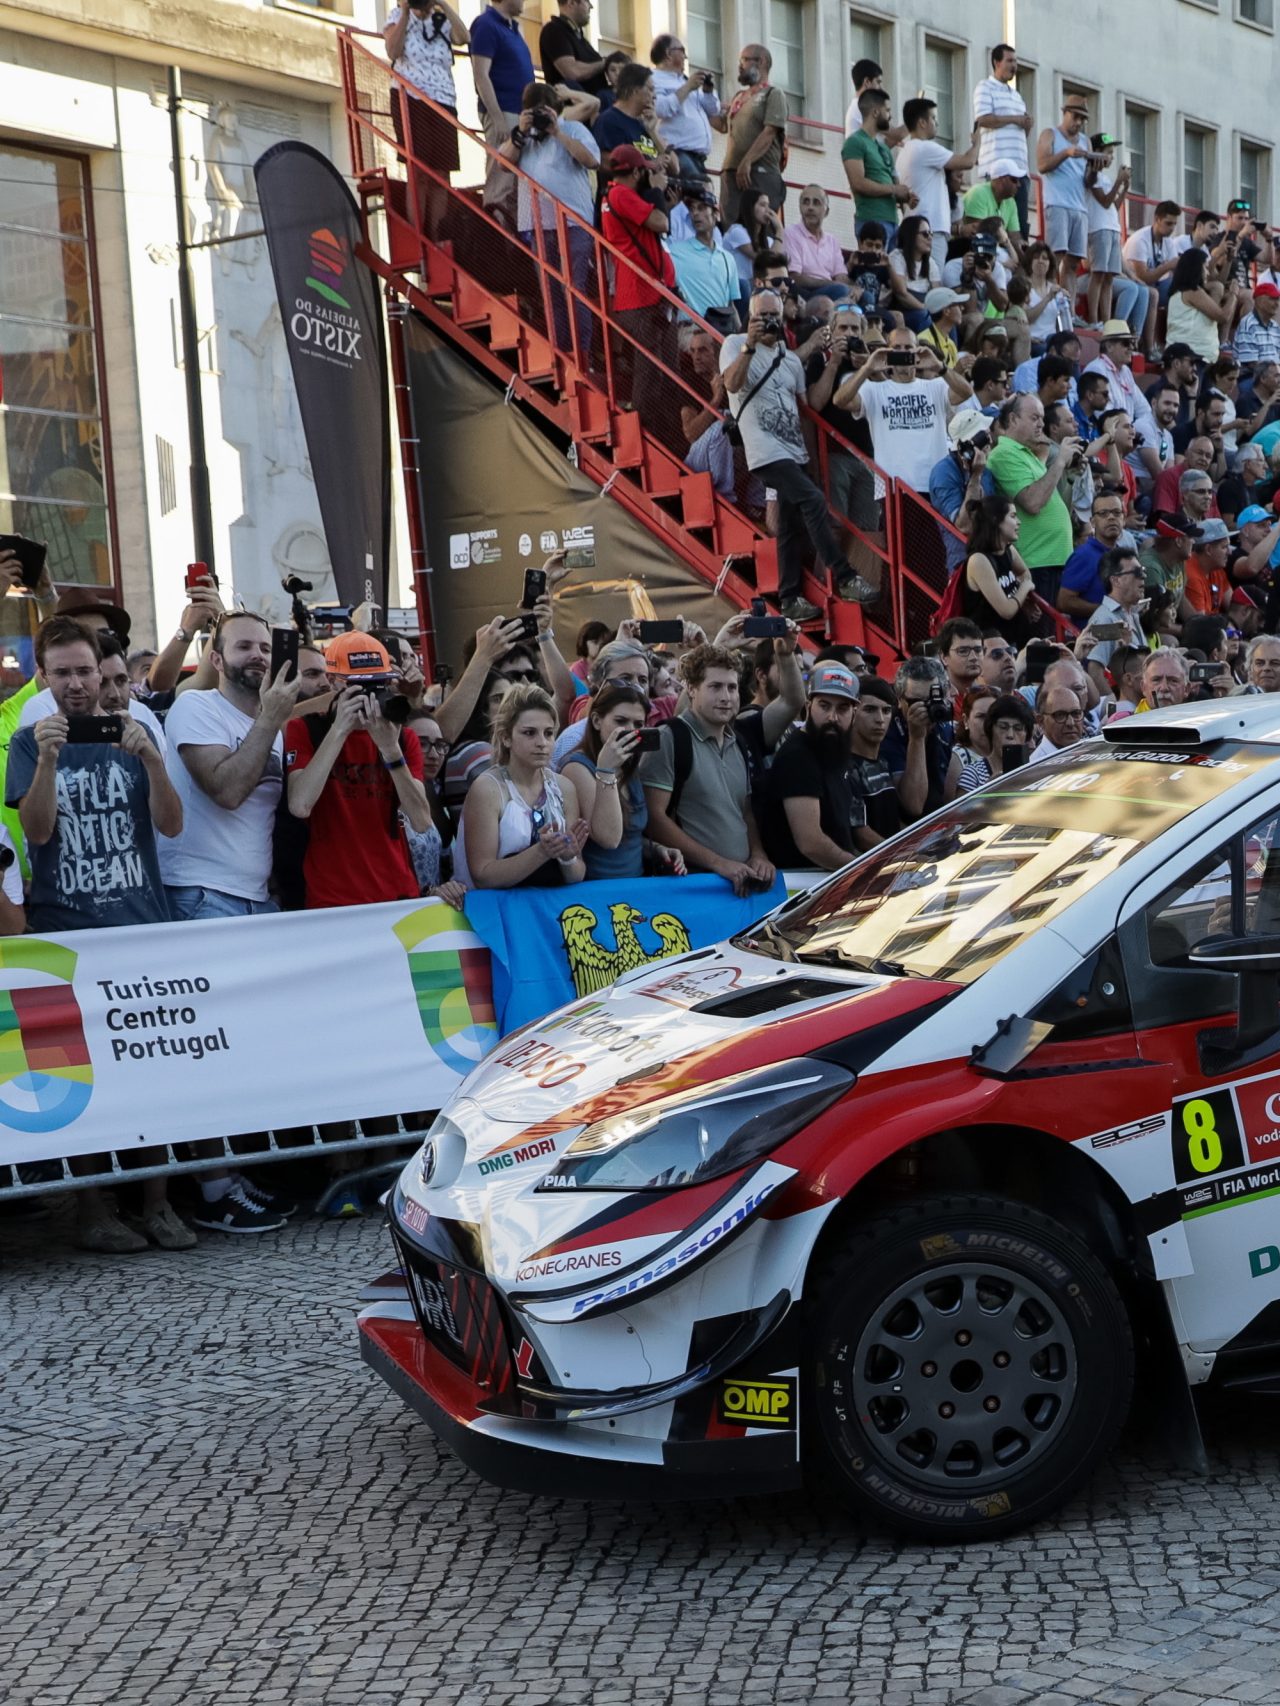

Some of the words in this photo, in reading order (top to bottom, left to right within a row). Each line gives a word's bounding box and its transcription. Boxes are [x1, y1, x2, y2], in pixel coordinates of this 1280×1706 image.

[882, 404, 936, 419] NORTHWEST
[888, 394, 928, 409] PACIFIC
[1127, 751, 1191, 763] GAZOO
[1188, 754, 1249, 773] Racing
[55, 766, 128, 811] ATLA
[60, 854, 143, 895] OCEAN
[96, 975, 210, 1001] Turismo
[106, 1005, 196, 1031] Centro
[111, 1027, 230, 1061] Portugal
[563, 1010, 664, 1063] Microsoft
[494, 1039, 587, 1089] DENSO
[1182, 1099, 1223, 1173] 8
[477, 1149, 514, 1176] DMG
[513, 1138, 557, 1164] MORI
[543, 1174, 577, 1188] PIAA
[1184, 1187, 1212, 1201] WRC
[1223, 1179, 1246, 1196] FIA
[572, 1183, 774, 1314] Panasonic
[966, 1233, 1068, 1280] MICHELIN
[515, 1250, 622, 1284] KONECRANES
[723, 1386, 790, 1415] OMP
[863, 1474, 967, 1518] MICHELIN
